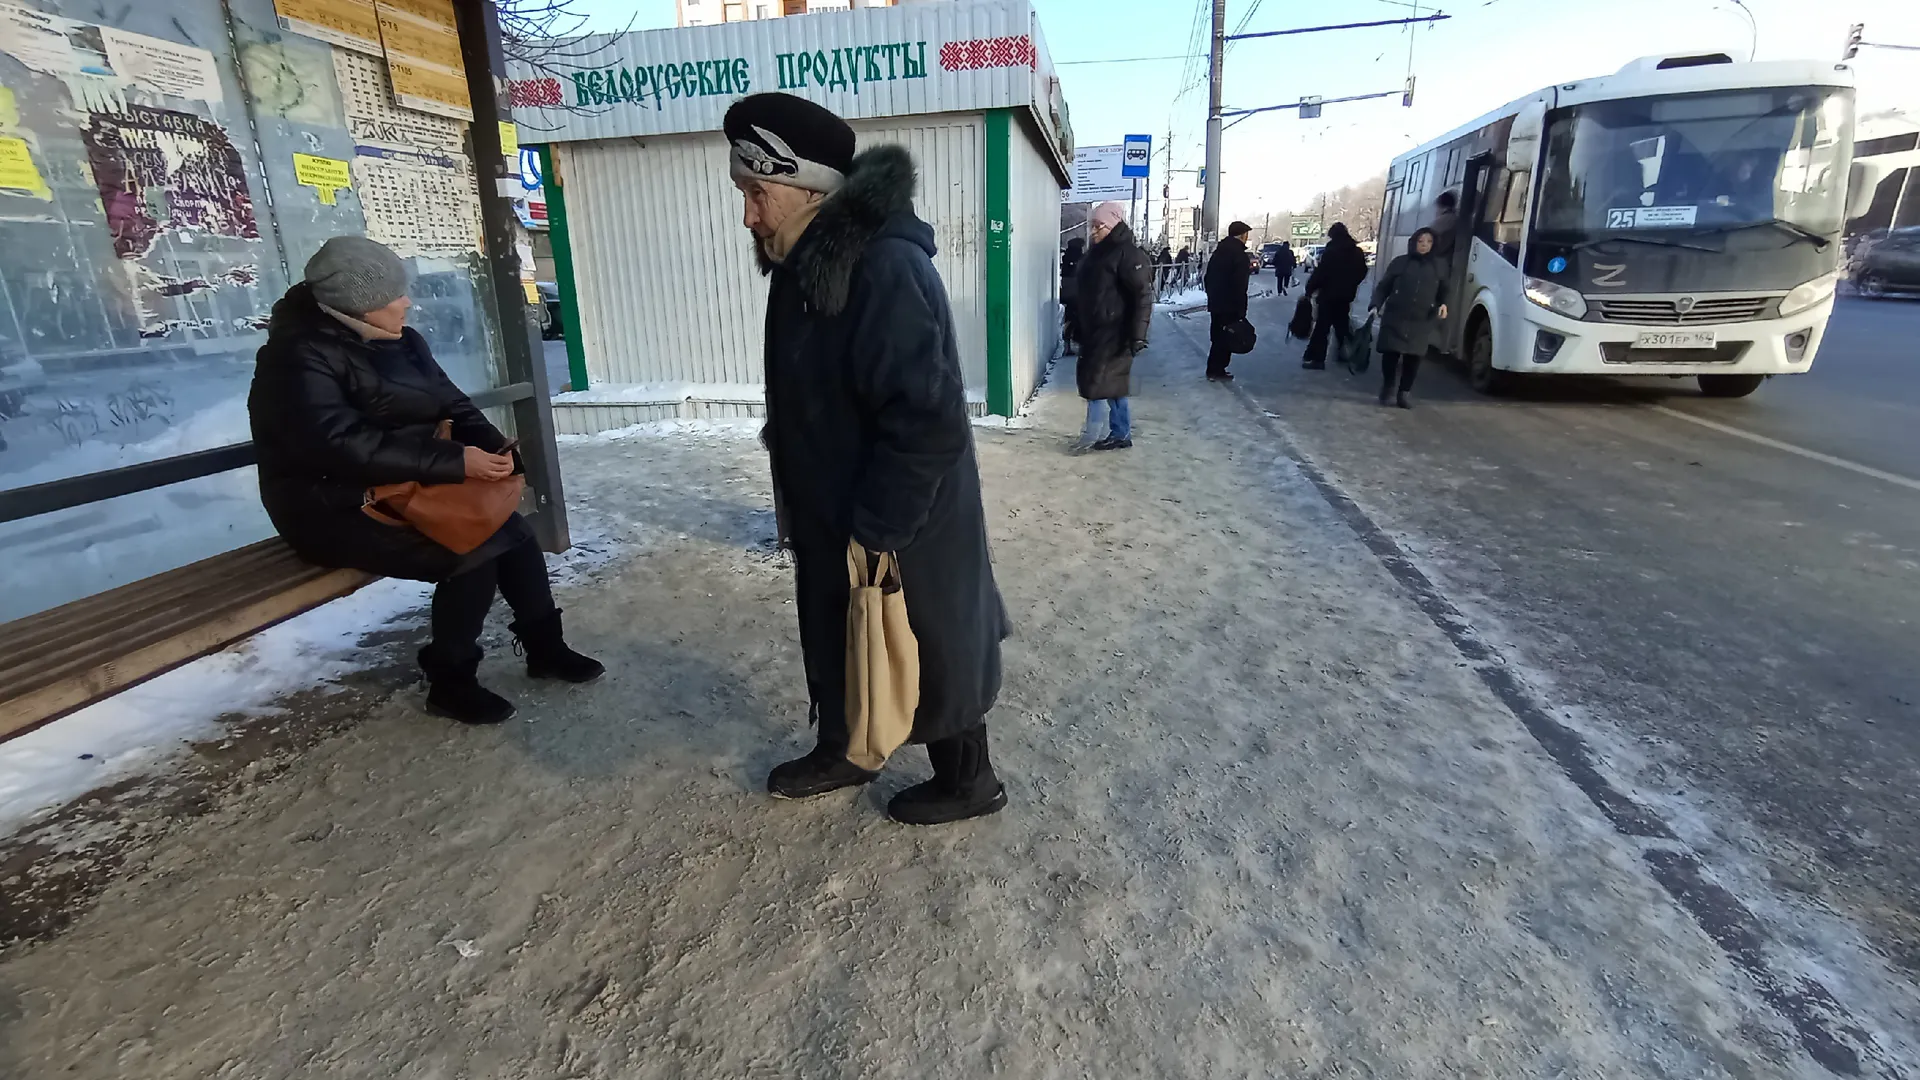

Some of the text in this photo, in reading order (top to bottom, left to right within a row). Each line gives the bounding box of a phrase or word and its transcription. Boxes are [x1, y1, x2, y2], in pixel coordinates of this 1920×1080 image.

[571, 41, 927, 111] БЕЛОРУССКИЕ ПРОДУКТЫ
[1609, 210, 1635, 229] 25
[1592, 262, 1627, 288] Z
